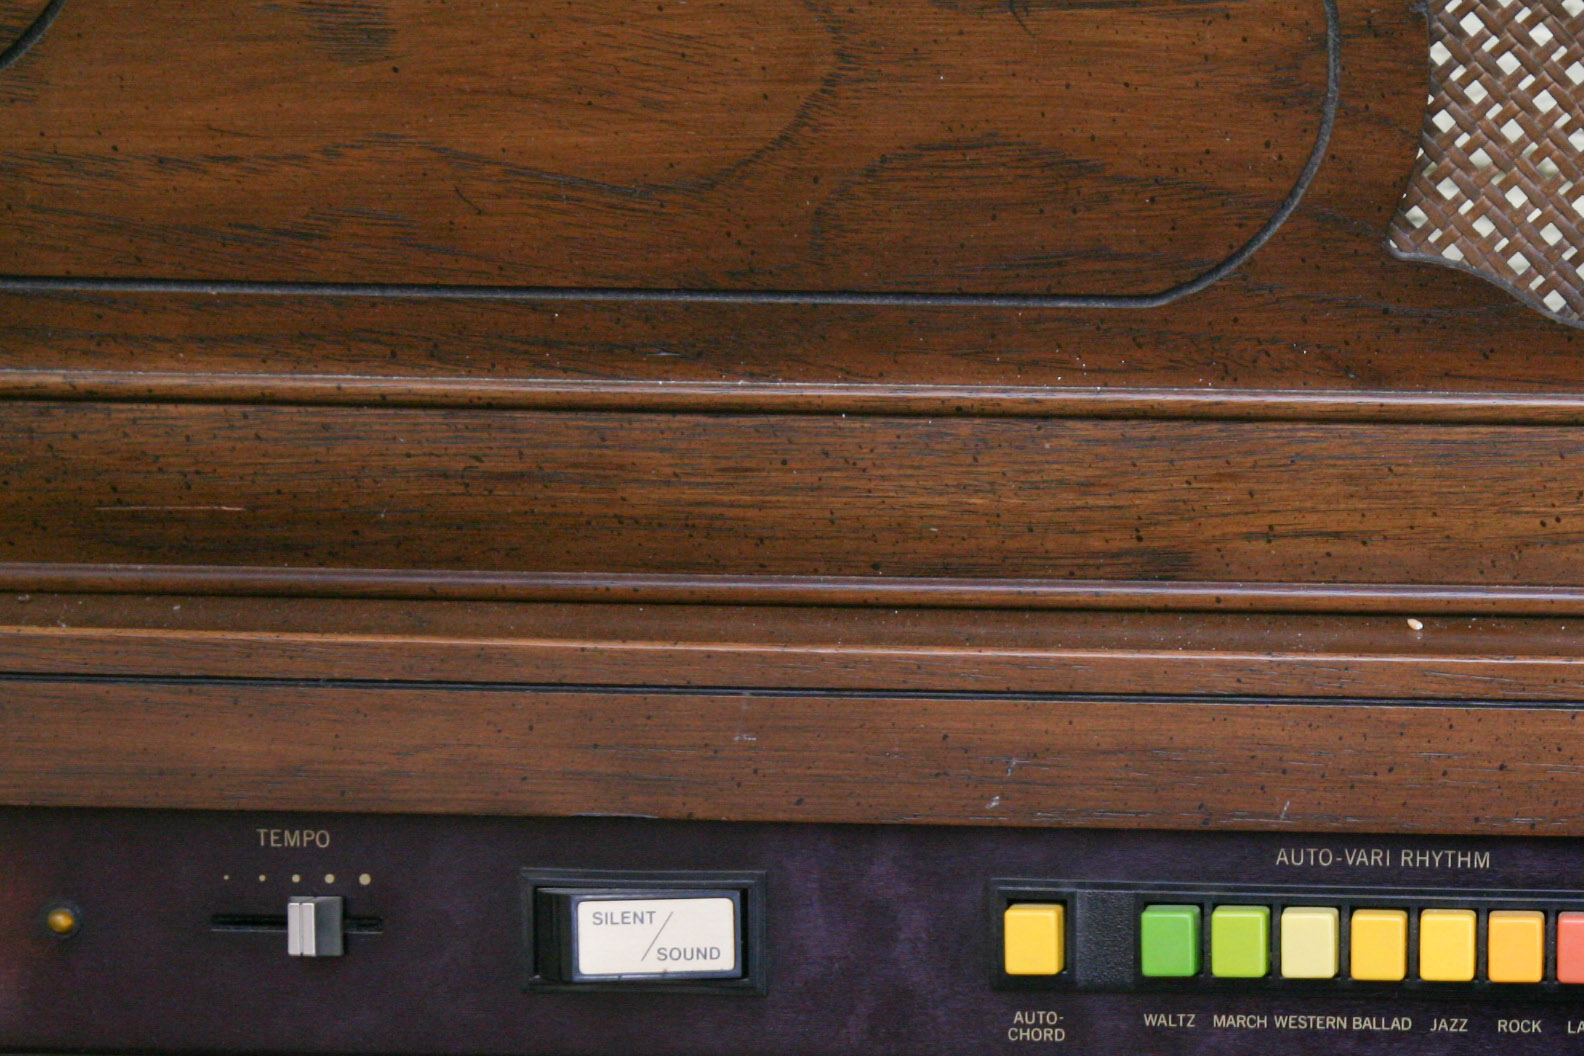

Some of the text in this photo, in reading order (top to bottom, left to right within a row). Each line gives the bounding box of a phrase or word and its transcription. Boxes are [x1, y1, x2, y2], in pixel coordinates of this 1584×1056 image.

[257, 828, 330, 848] TEMPO
[1276, 847, 1491, 869] AUTO-VARI RHYTHM
[592, 910, 656, 926] SILENT
[656, 946, 721, 962] SOUND
[1013, 1010, 1065, 1026] AUTO-
[1143, 1013, 1196, 1028] WALTZ
[1213, 1014, 1268, 1029] MARCH
[1274, 1015, 1348, 1030] WESTERN
[1352, 1016, 1412, 1031] BALLAD
[1430, 1018, 1468, 1033] JAZZ
[1497, 1019, 1542, 1034] ROCK
[1007, 1028, 1066, 1042] CHORD
